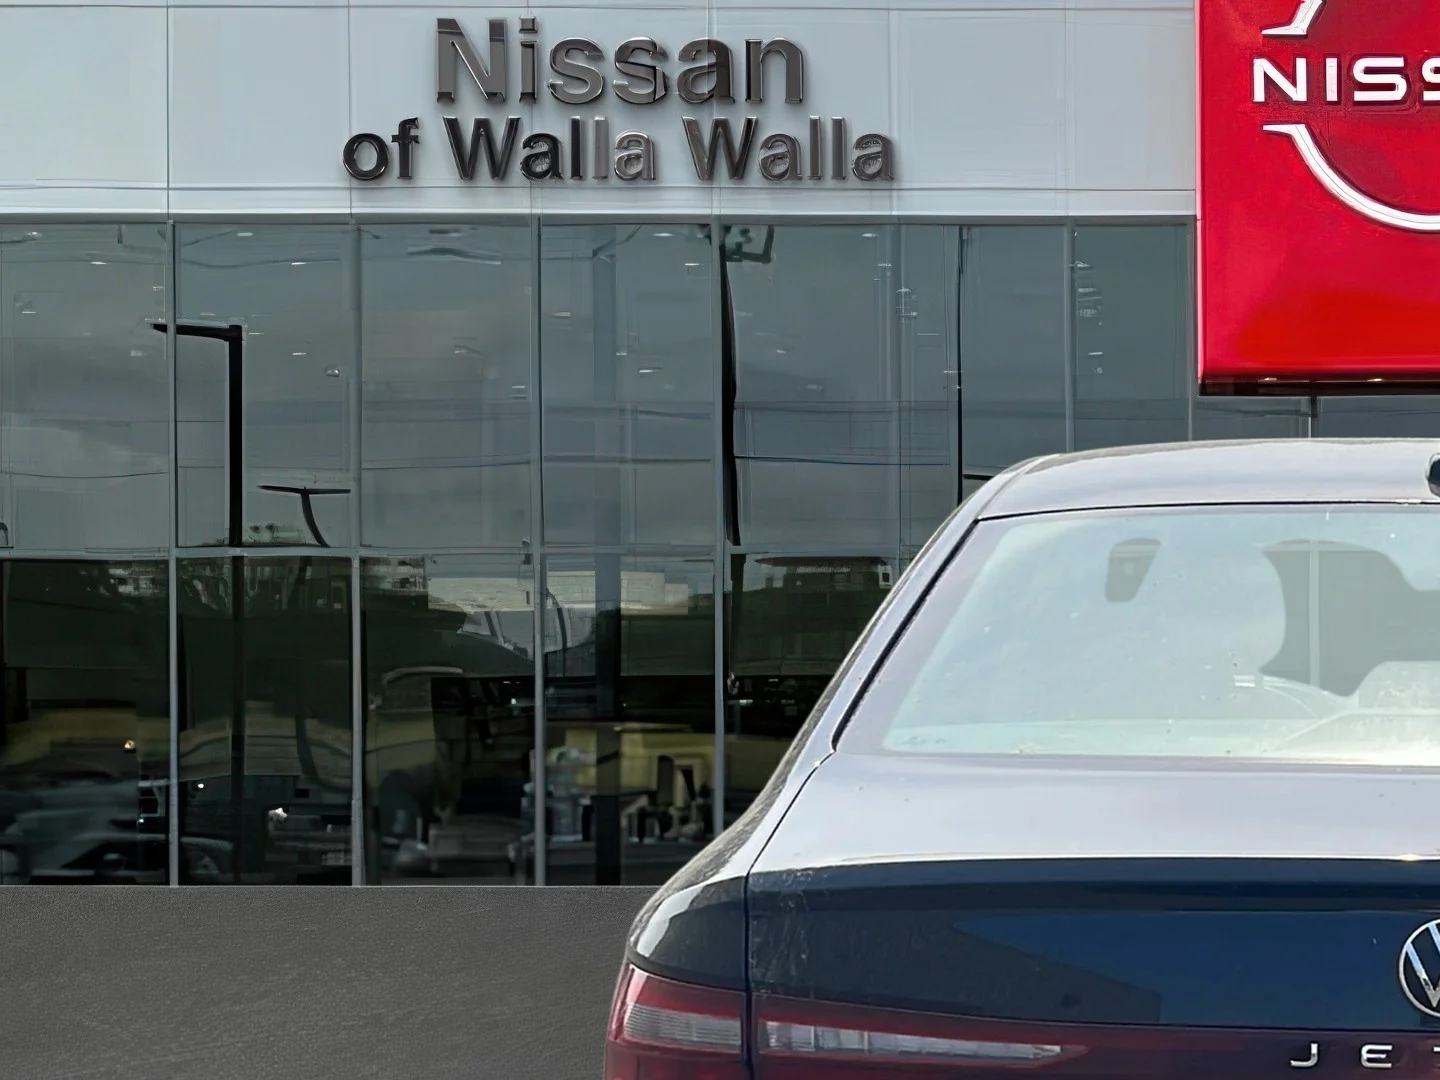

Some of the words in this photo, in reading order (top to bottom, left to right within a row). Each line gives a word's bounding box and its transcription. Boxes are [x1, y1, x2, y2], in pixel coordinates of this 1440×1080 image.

[436, 17, 806, 104] Nissan
[342, 116, 420, 181] of
[442, 116, 656, 181] Walla
[681, 115, 895, 181] Walla
